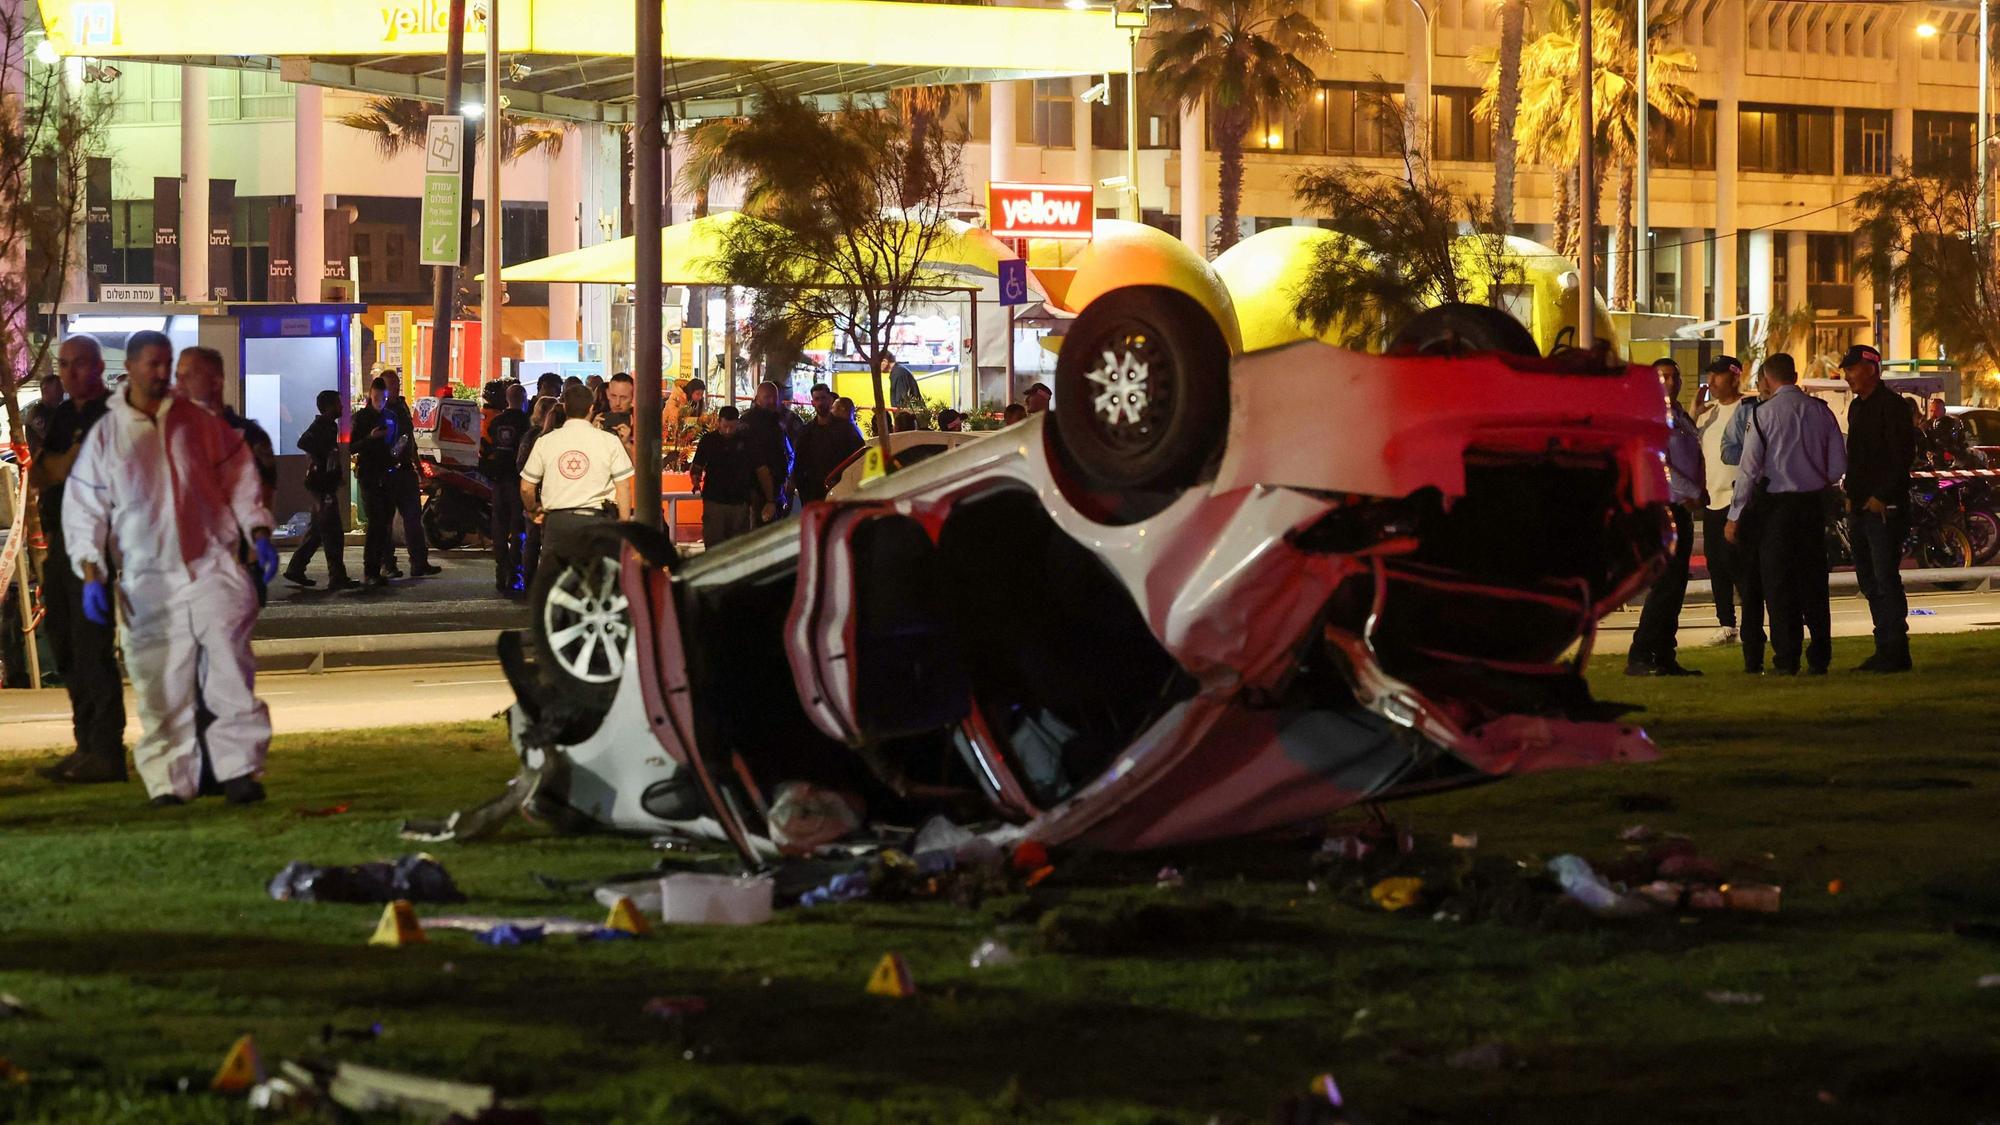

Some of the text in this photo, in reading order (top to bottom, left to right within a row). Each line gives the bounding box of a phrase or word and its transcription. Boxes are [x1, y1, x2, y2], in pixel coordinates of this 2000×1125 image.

[1002, 191, 1081, 229] yellow
[155, 232, 177, 244] brut
[209, 233, 231, 245] brut
[270, 264, 292, 276] brut
[106, 287, 131, 299] תשלום
[132, 288, 154, 299] עמדת
